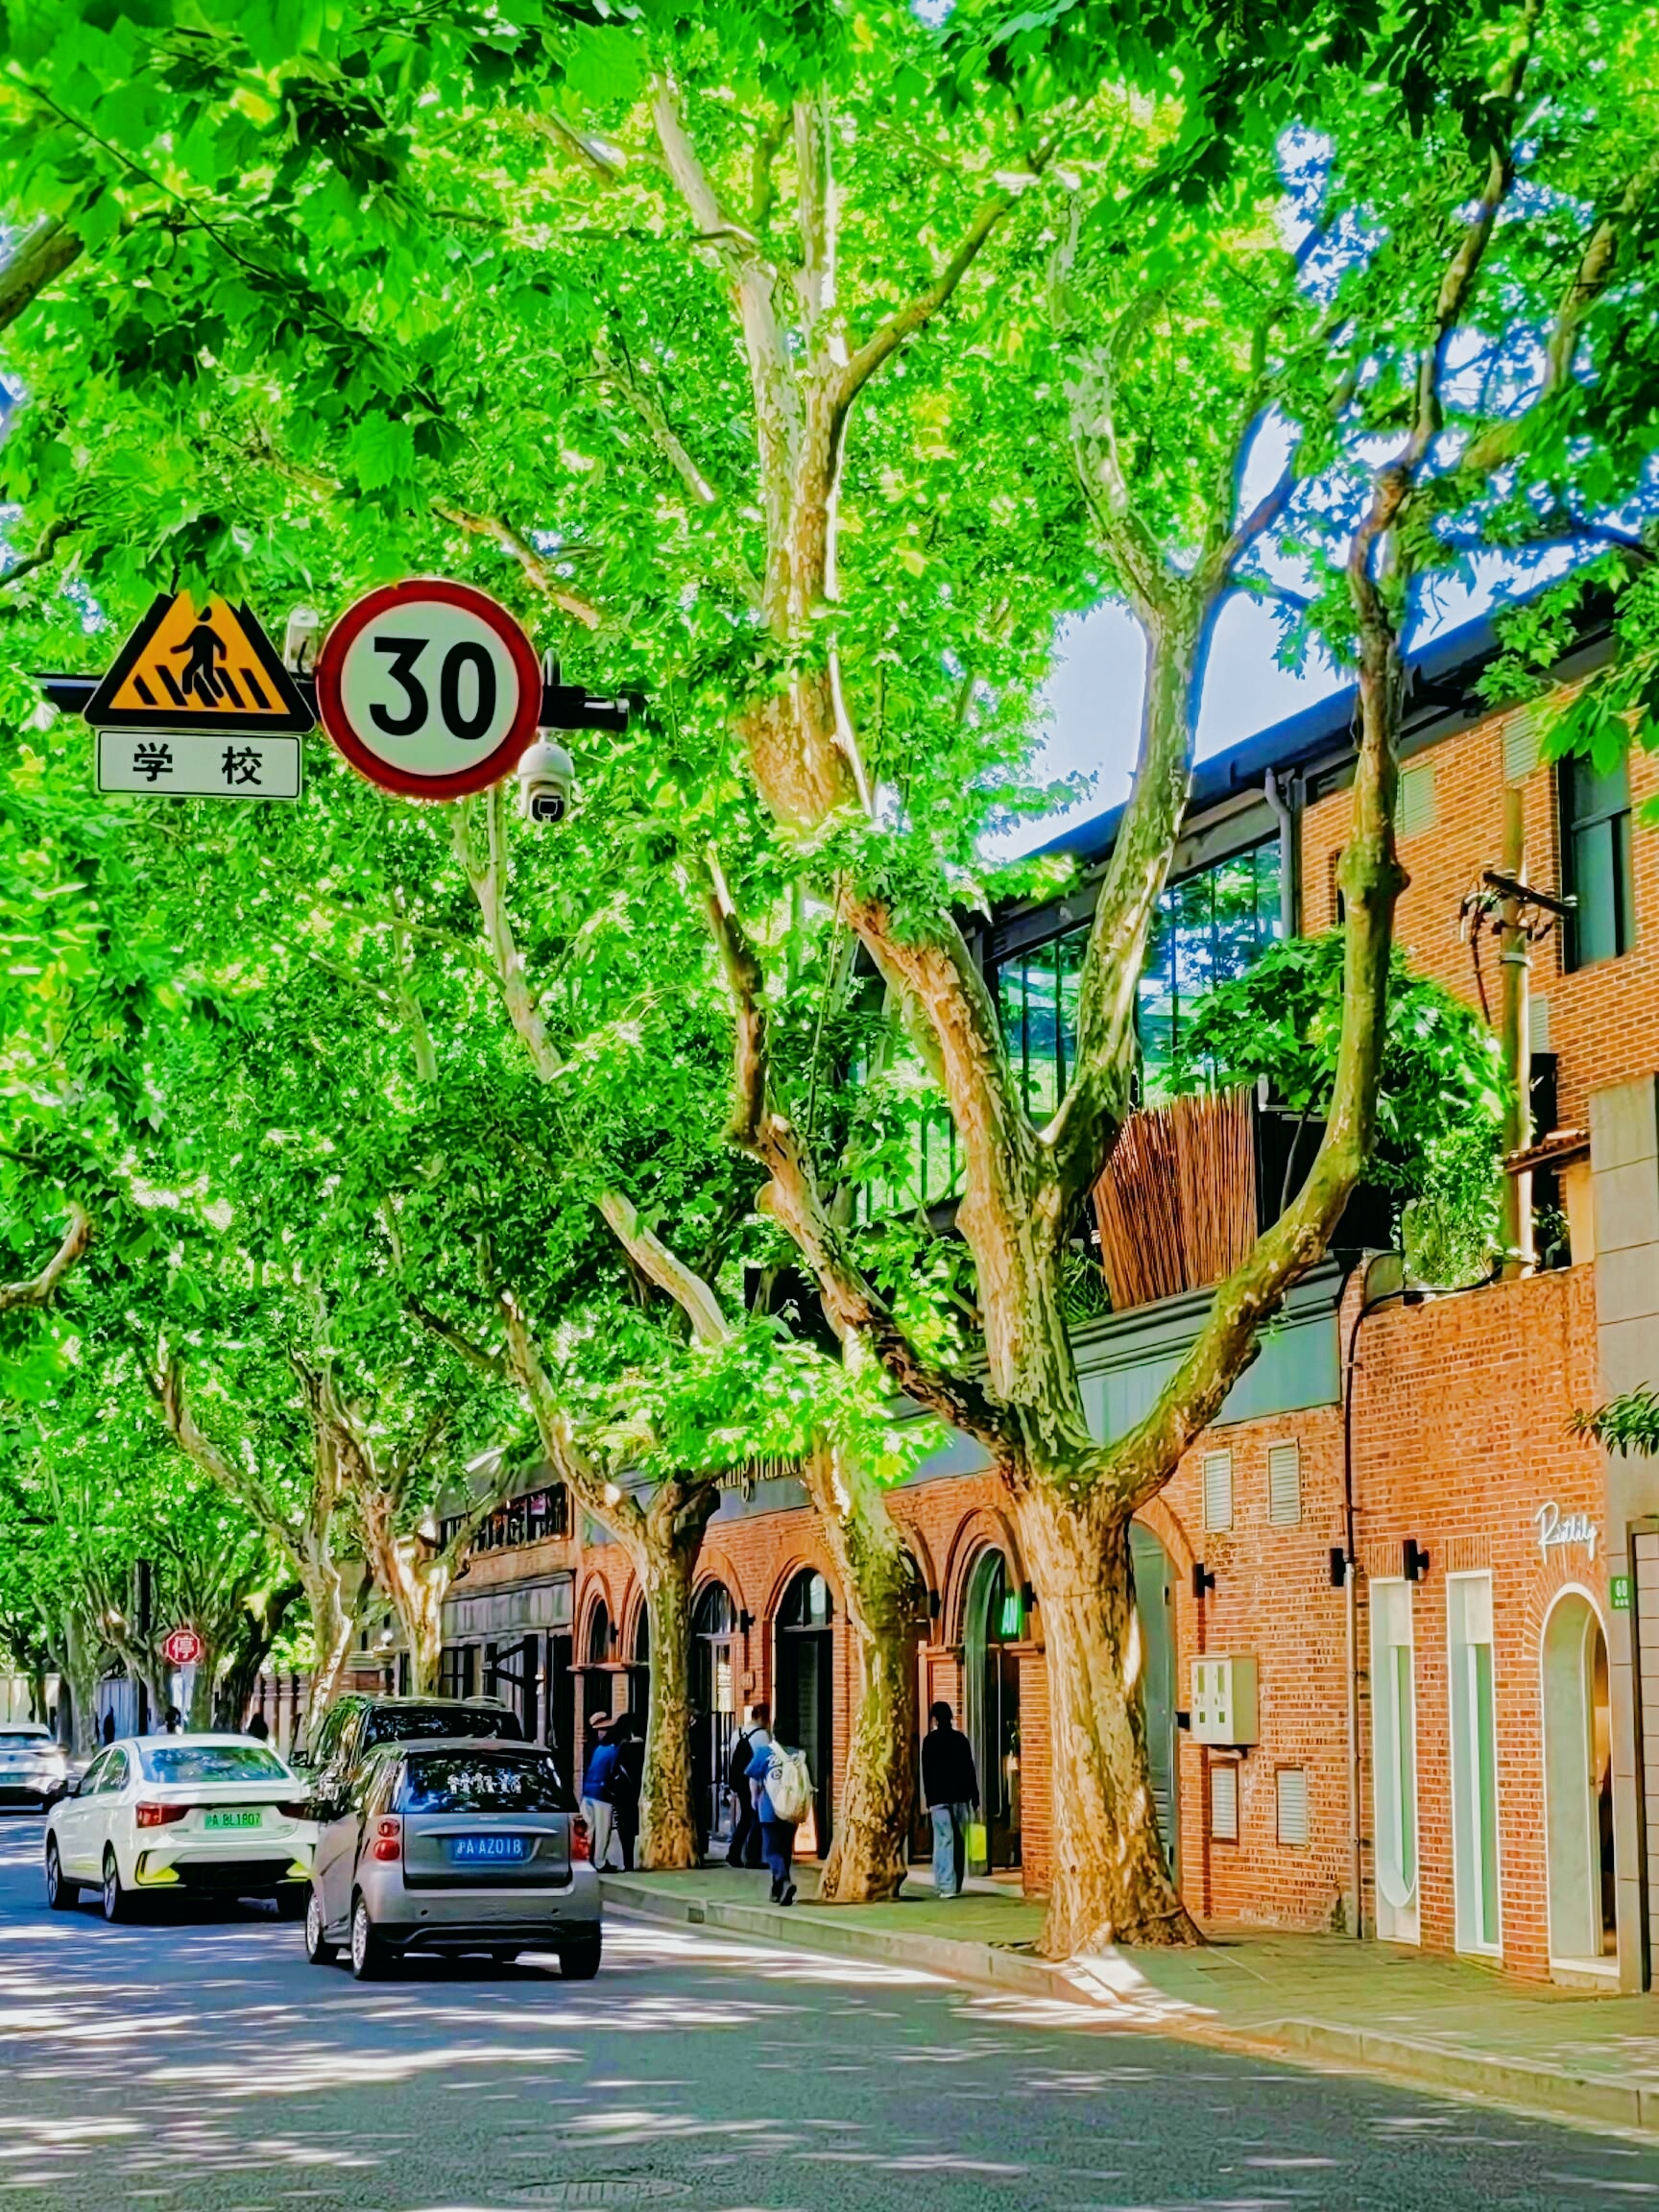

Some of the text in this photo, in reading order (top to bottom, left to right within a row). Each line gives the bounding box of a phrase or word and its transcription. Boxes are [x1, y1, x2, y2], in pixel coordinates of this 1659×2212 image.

[370, 637, 496, 740] 30
[132, 742, 263, 785] 学校
[1615, 1579, 1628, 1598] 60
[172, 1635, 195, 1659] 停
